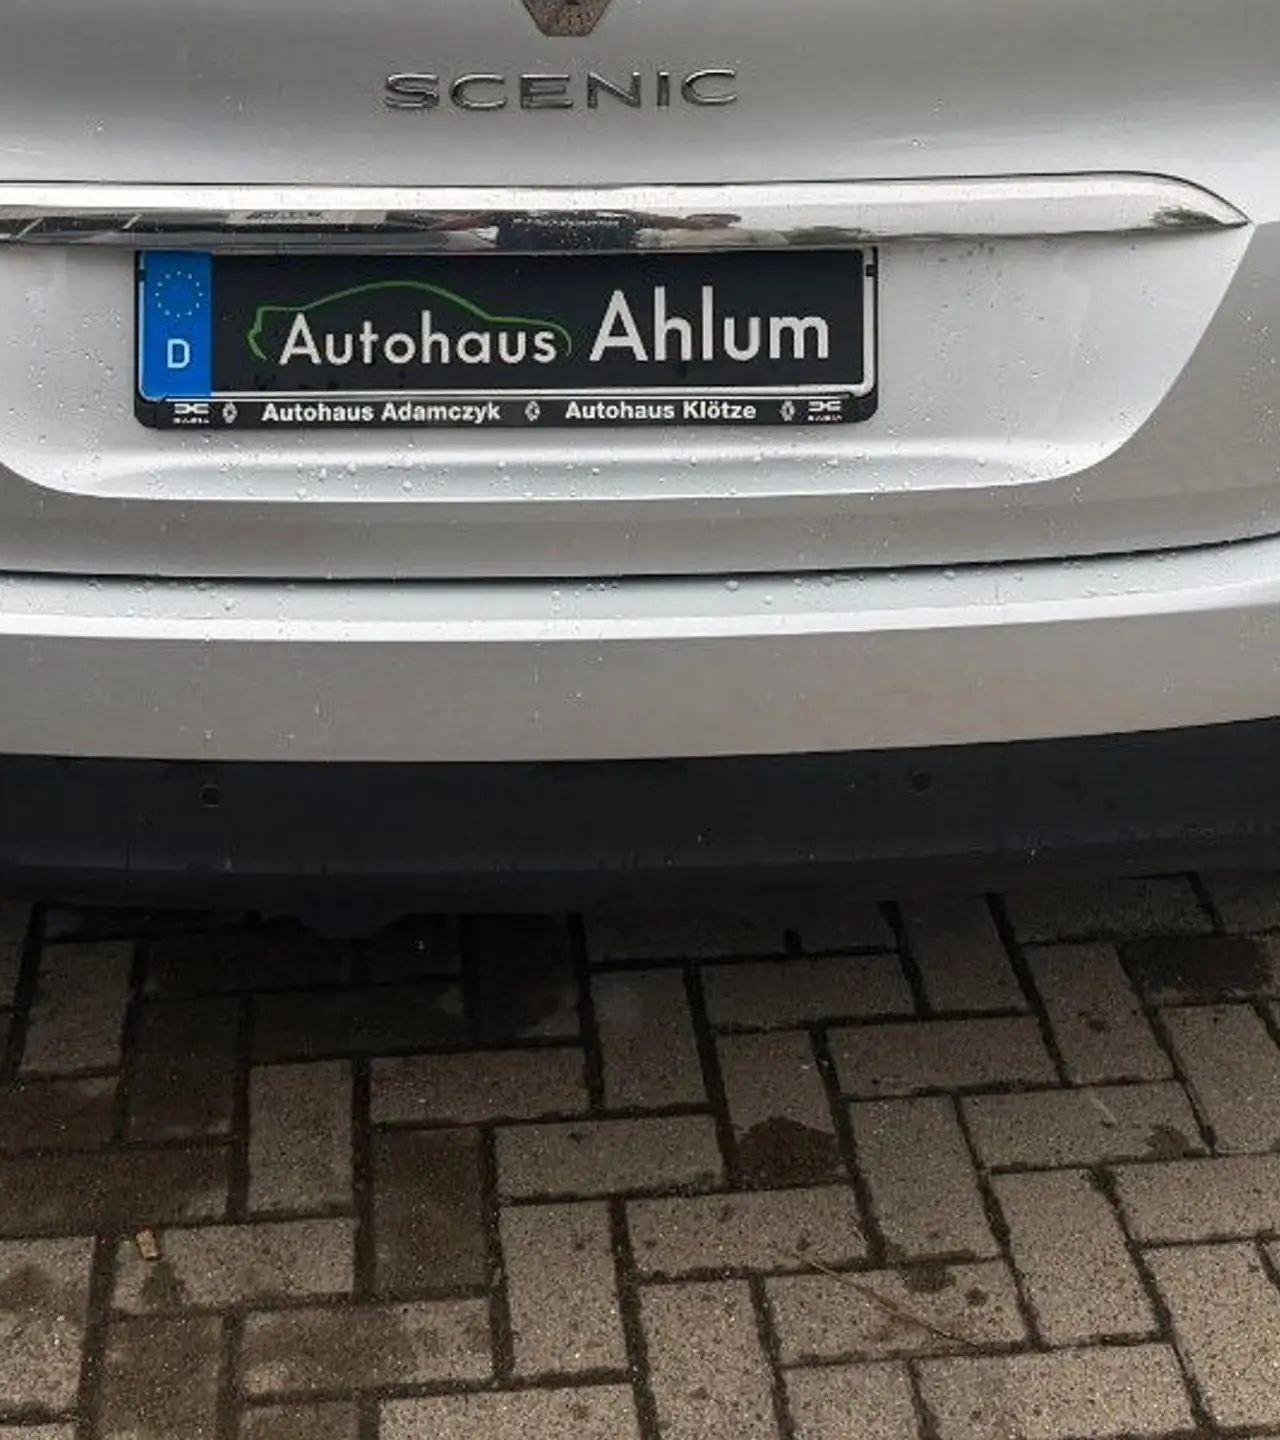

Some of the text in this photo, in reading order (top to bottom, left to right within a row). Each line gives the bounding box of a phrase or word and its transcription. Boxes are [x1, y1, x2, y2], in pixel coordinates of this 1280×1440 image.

[384, 68, 738, 110] SCENIC
[278, 285, 830, 366] Autohaus Ahlum
[167, 338, 190, 368] D
[261, 399, 757, 425] Autohaus Adamczyk Autohaus Klötze
